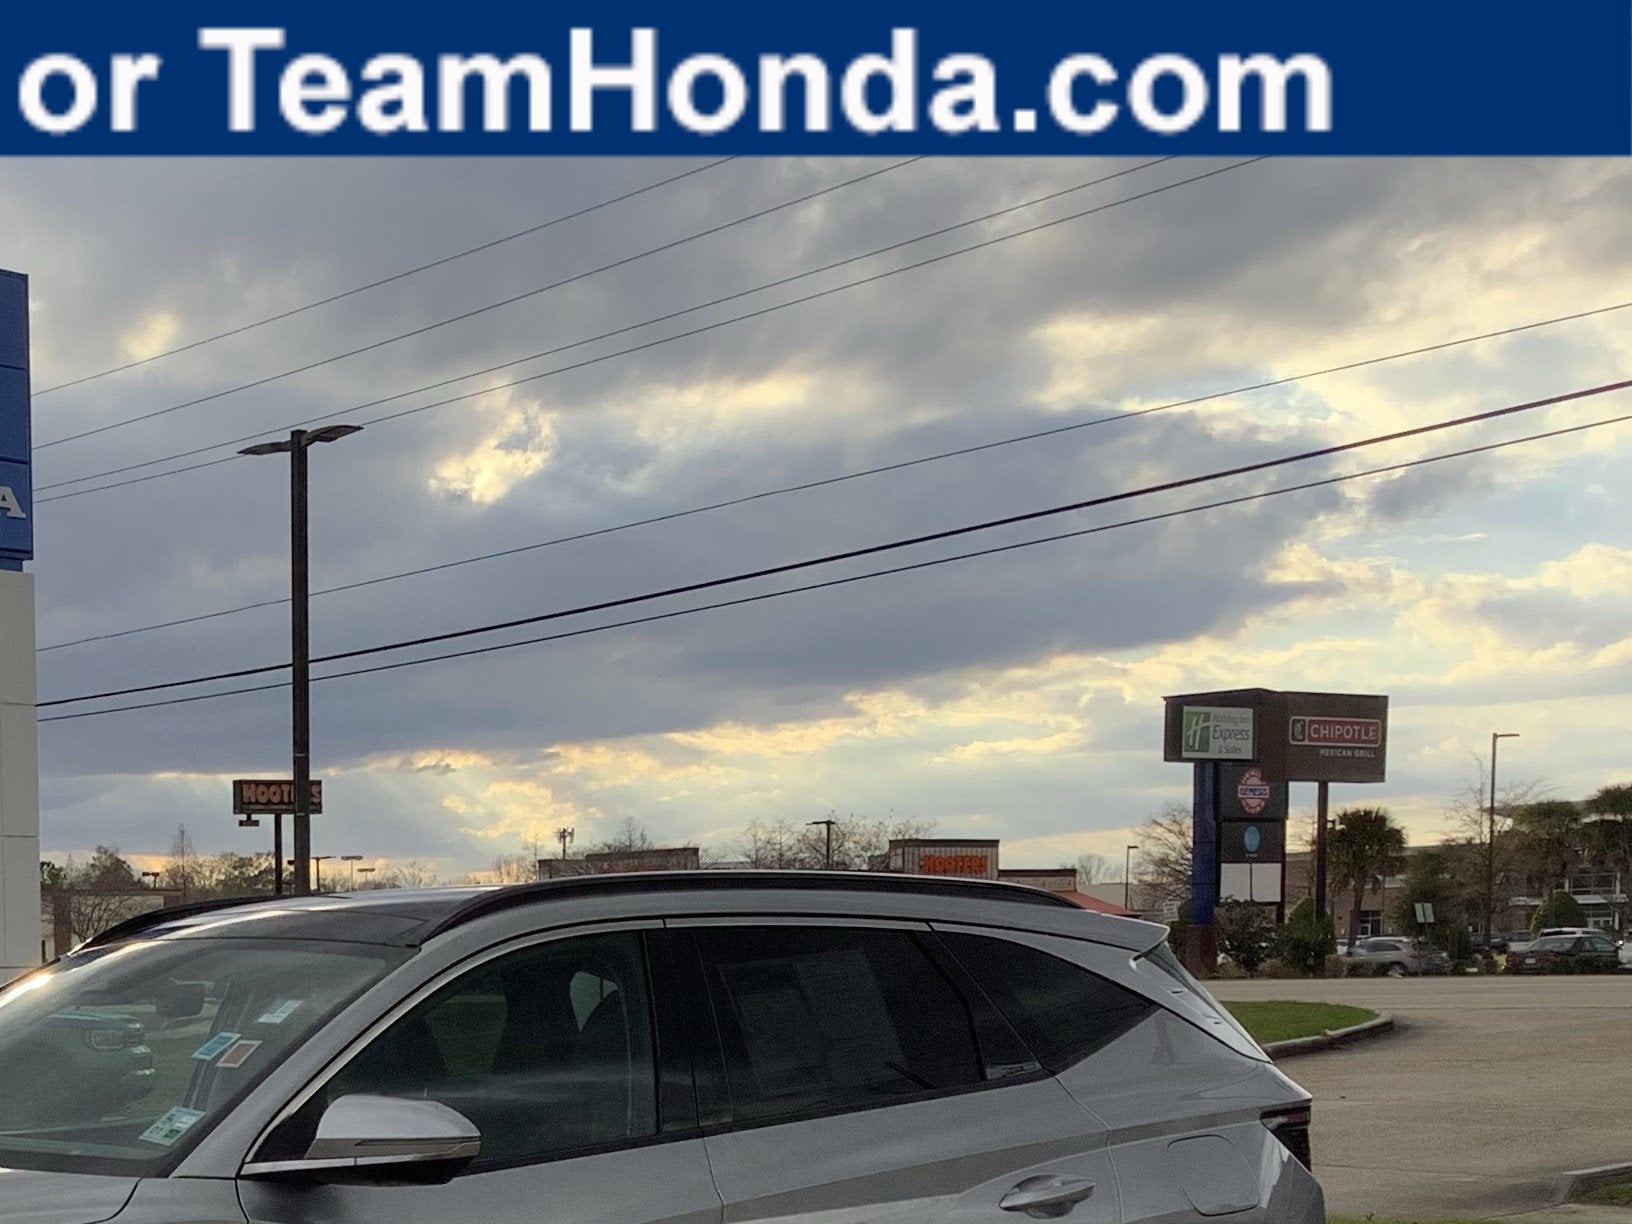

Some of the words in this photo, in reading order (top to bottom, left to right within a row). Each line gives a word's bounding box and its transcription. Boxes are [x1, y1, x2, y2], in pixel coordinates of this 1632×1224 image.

[1213, 725, 1250, 743] Express
[1310, 724, 1377, 740] CHIPOTLE
[1320, 748, 1353, 757] MEXICAN
[242, 783, 321, 803] HOOTS
